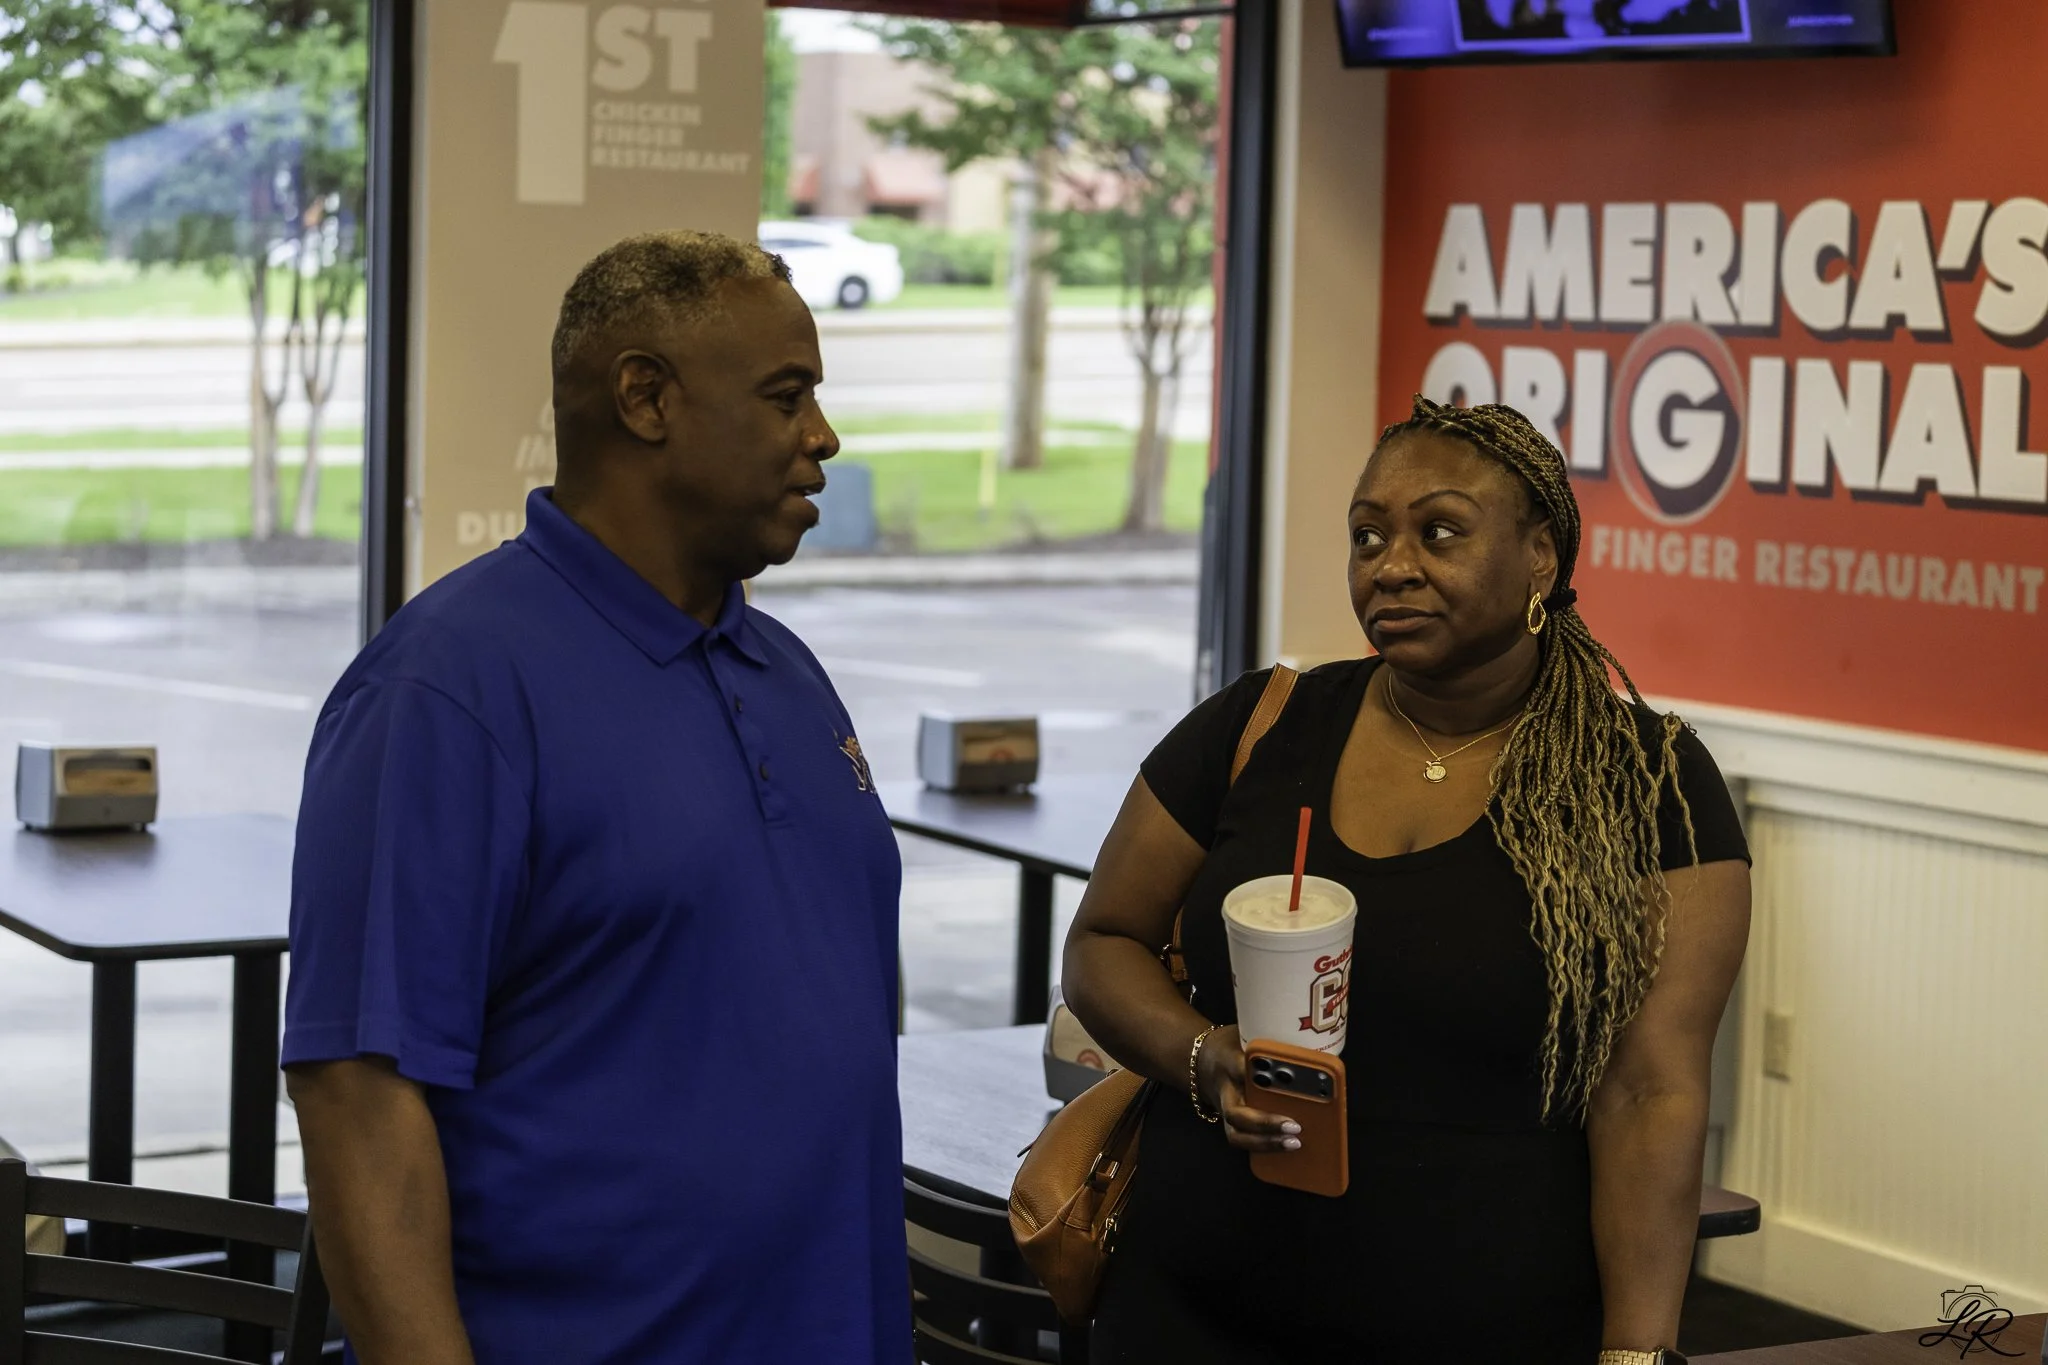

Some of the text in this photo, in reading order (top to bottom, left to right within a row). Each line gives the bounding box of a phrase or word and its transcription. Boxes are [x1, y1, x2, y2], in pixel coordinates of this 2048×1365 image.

[493, 1, 713, 204] 1ST
[592, 101, 702, 124] CHICKEN
[591, 147, 752, 175] RESTAURANT
[593, 124, 684, 146] FINGER
[1423, 197, 2048, 336] AMERICA'S
[1590, 524, 2045, 614] FINGER RESTAURANT
